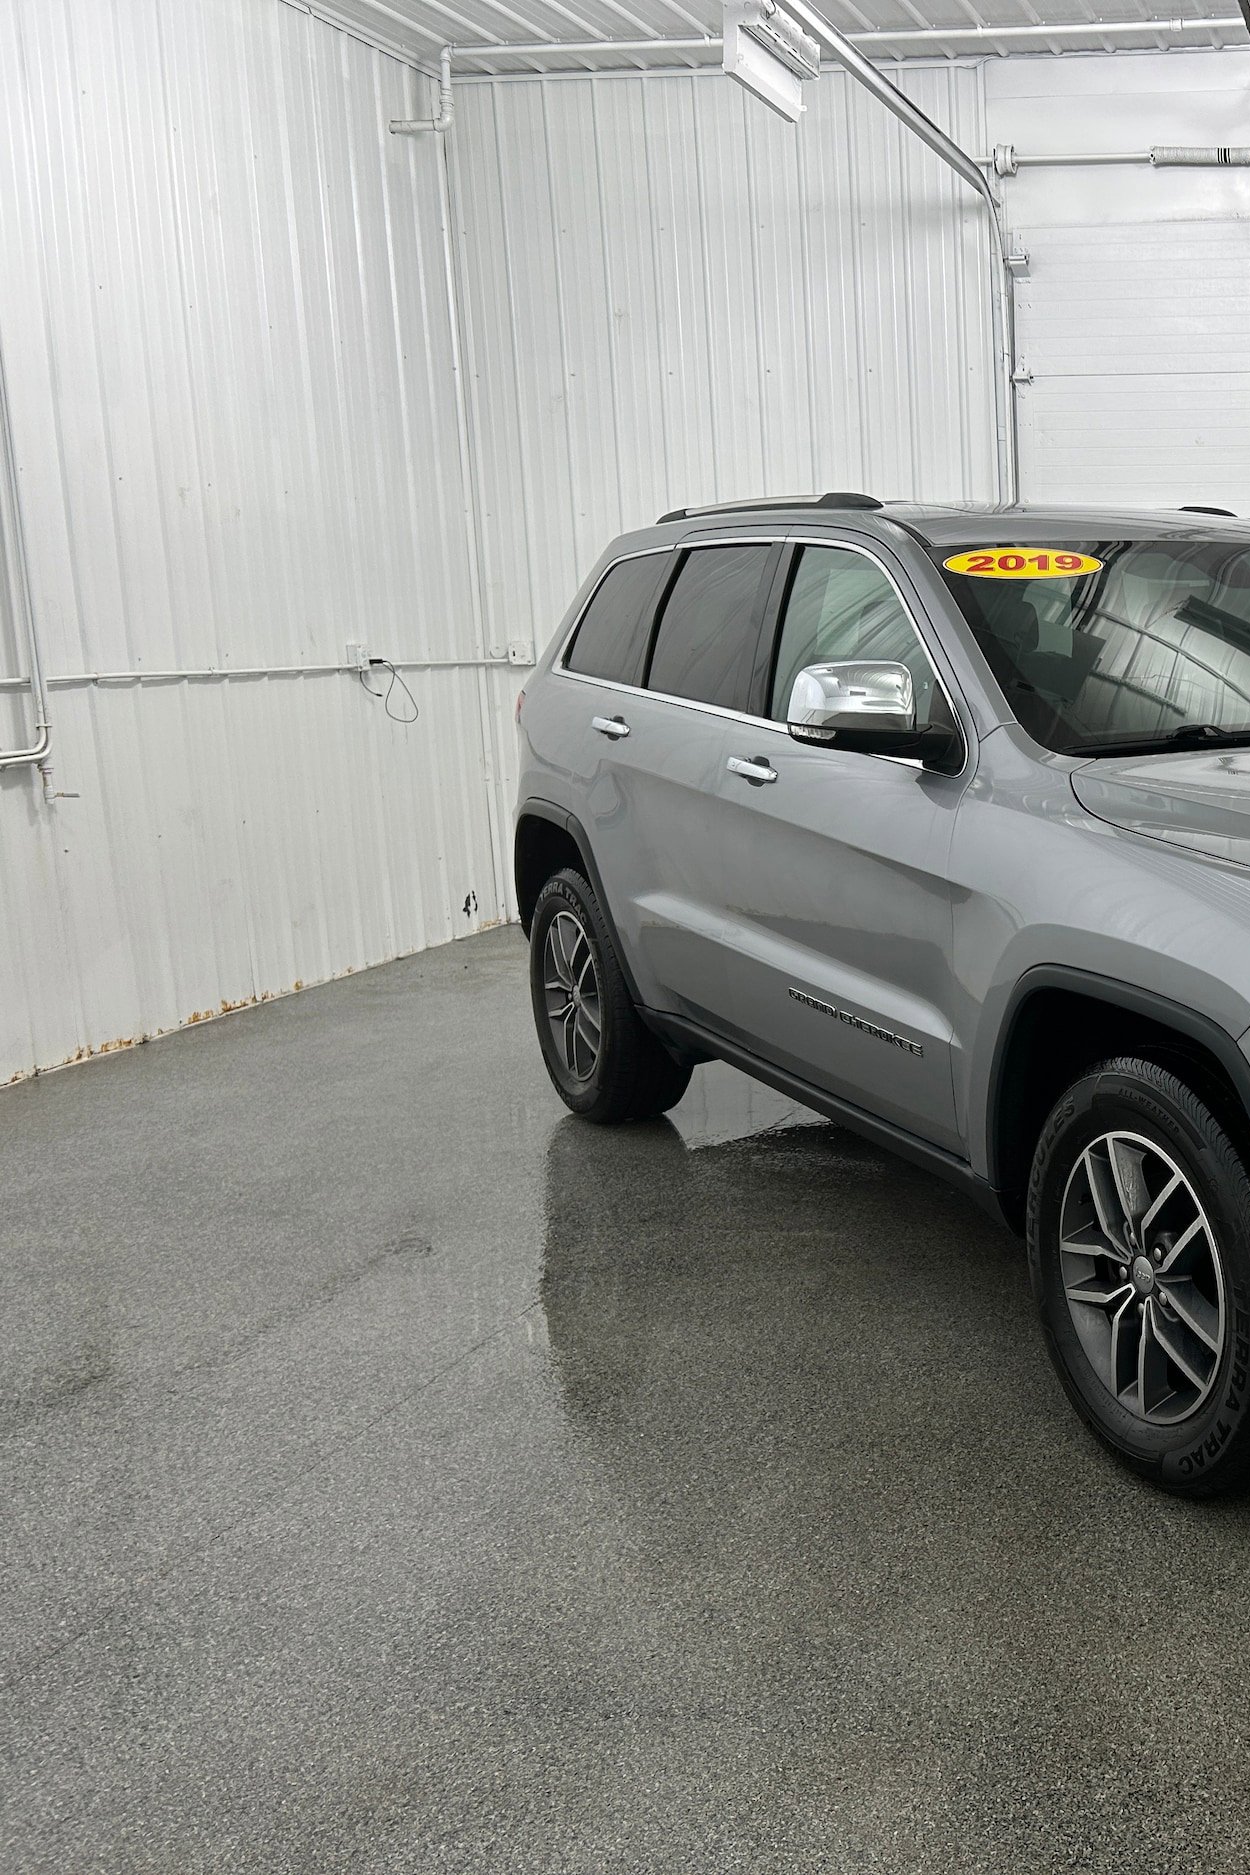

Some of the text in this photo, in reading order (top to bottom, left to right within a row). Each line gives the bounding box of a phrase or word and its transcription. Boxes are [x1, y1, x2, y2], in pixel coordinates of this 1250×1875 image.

[966, 554, 1084, 572] 2019
[538, 882, 587, 926] TERRA TRAC
[788, 987, 924, 1058] GRAND CHEROKEE
[1178, 1418, 1232, 1476] TRAC
